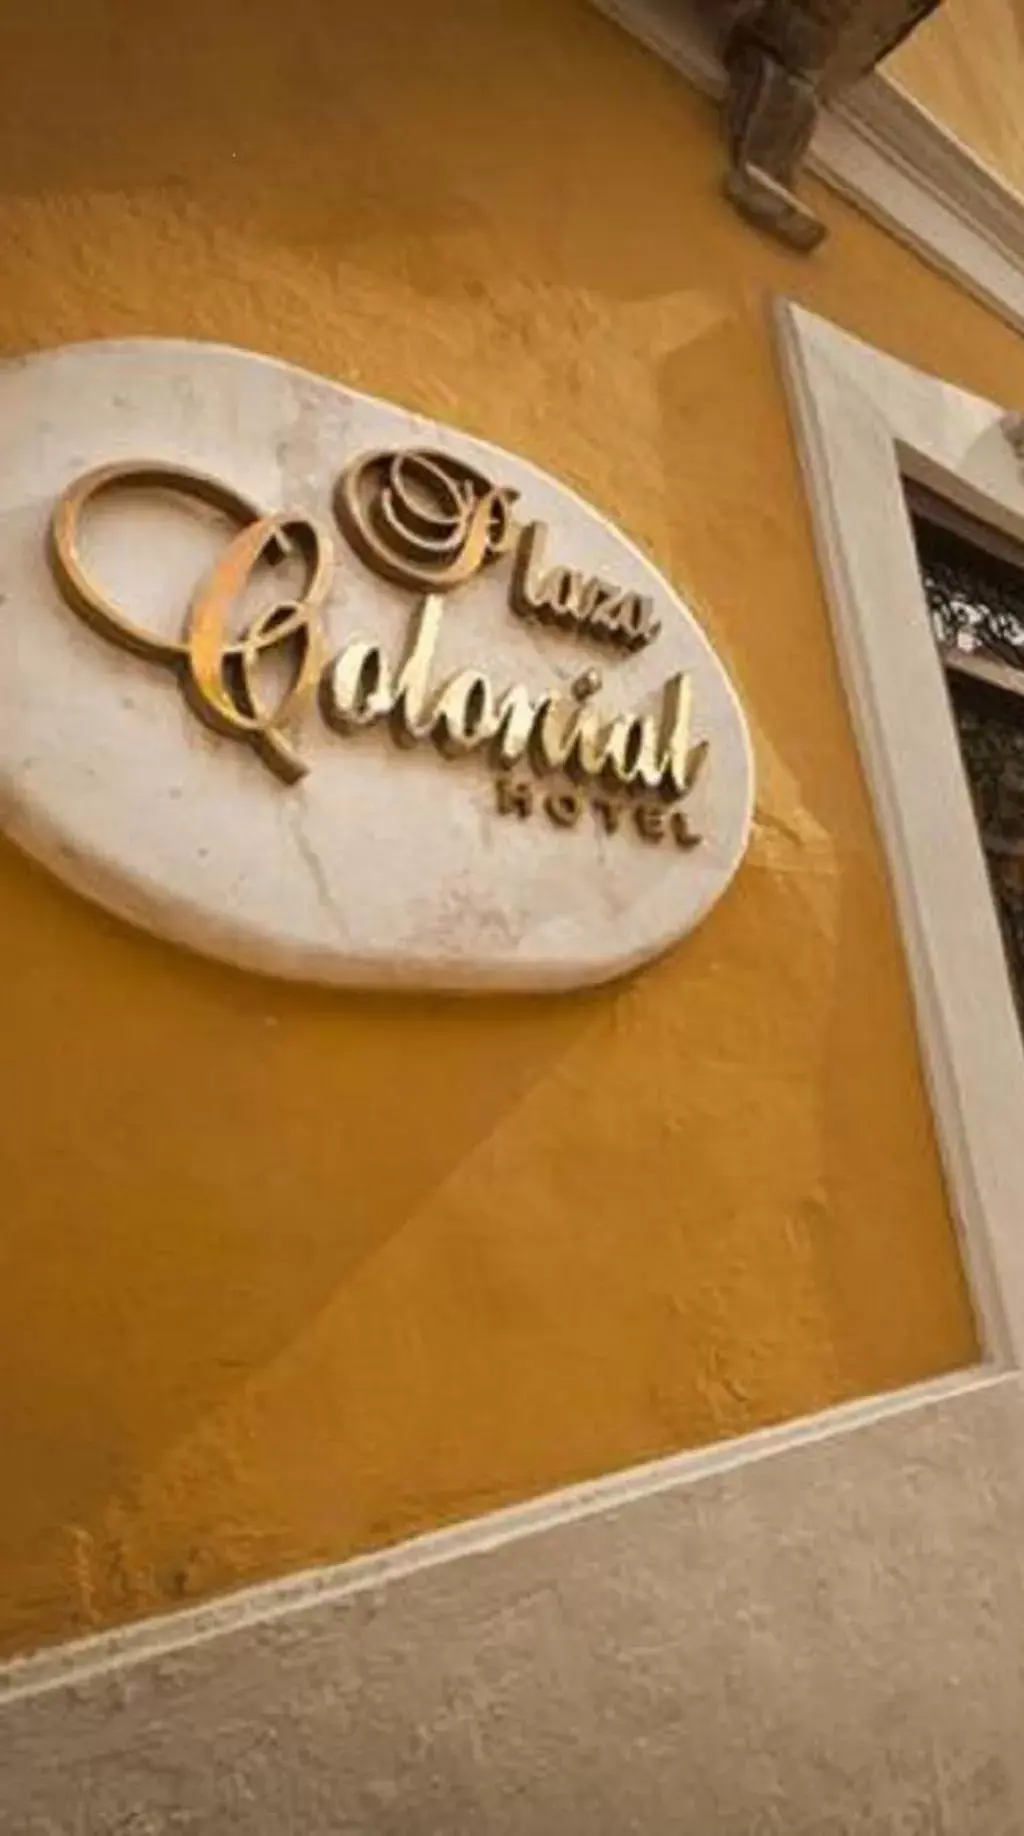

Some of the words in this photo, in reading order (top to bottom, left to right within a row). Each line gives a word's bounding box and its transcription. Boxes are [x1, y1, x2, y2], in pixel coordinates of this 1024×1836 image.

[49, 458, 709, 797] Colonial
[333, 448, 662, 652] Plaza
[495, 777, 703, 849] HOTEL
